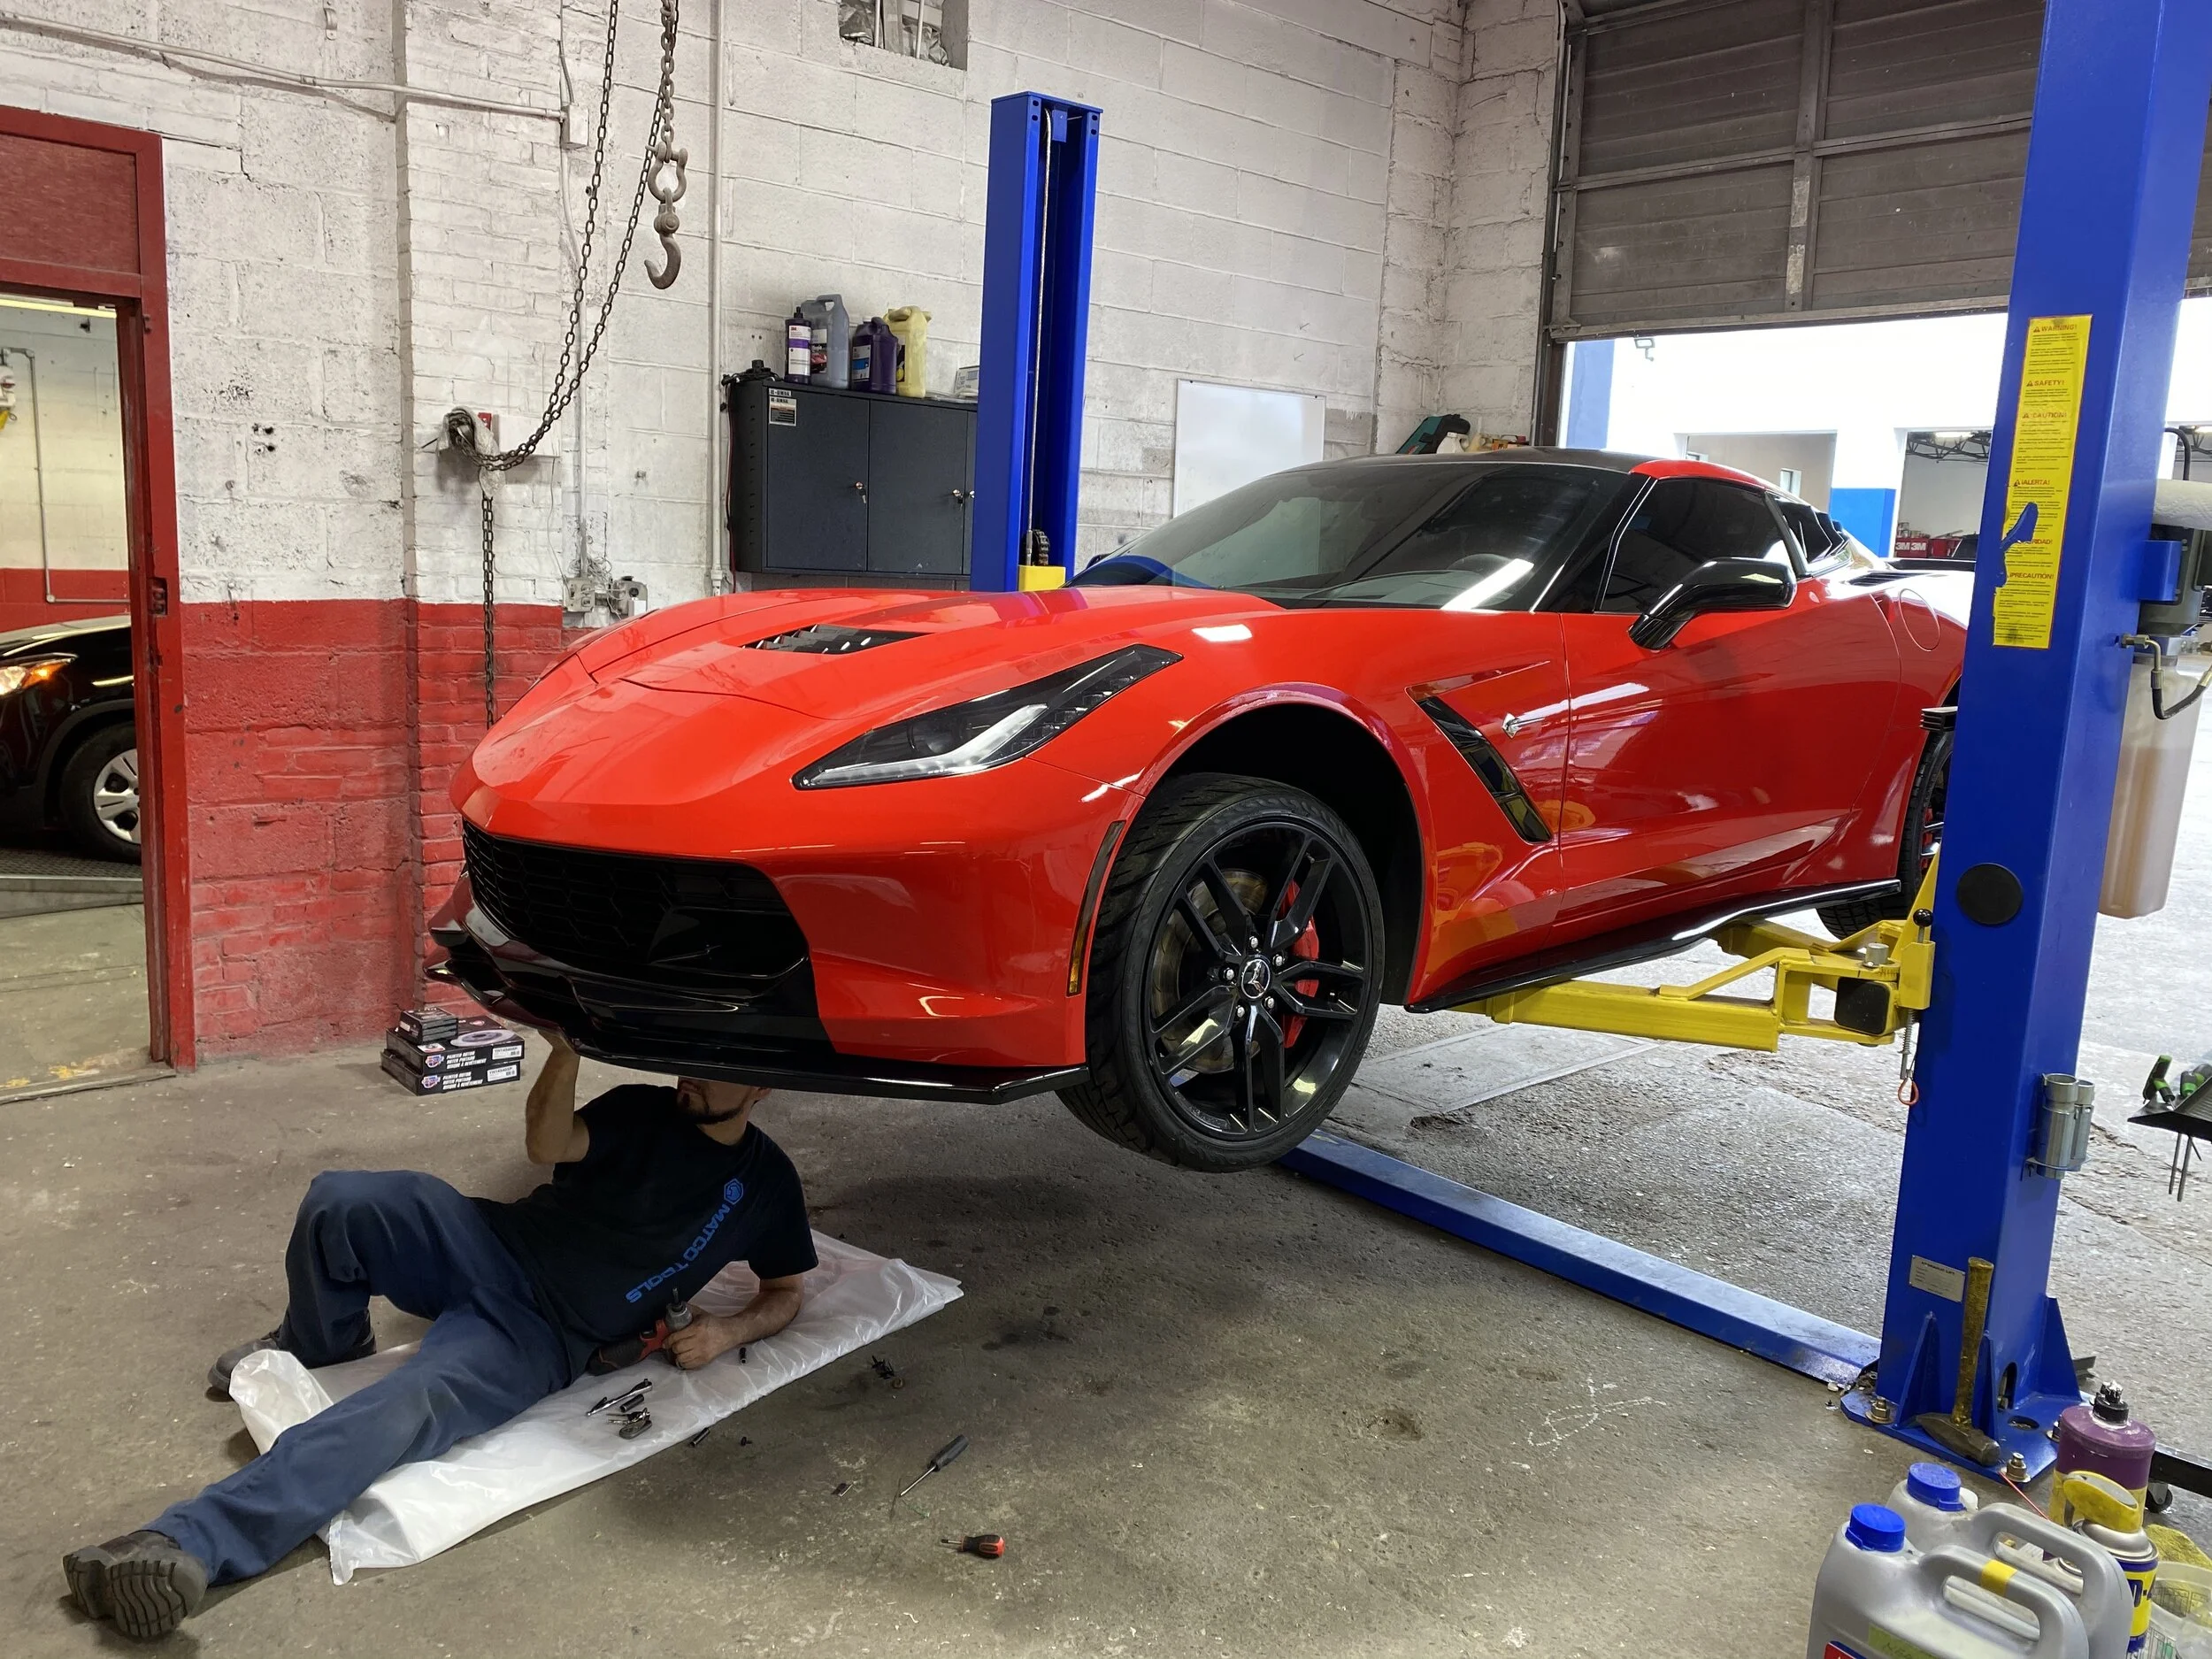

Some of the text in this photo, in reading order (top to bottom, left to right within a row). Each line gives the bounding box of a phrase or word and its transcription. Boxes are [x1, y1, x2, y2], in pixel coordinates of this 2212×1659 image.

[2041, 324, 2078, 333] WARNING!
[1895, 541, 1926, 550] 3M 3M
[625, 1203, 731, 1303] MATCO TOOLS
